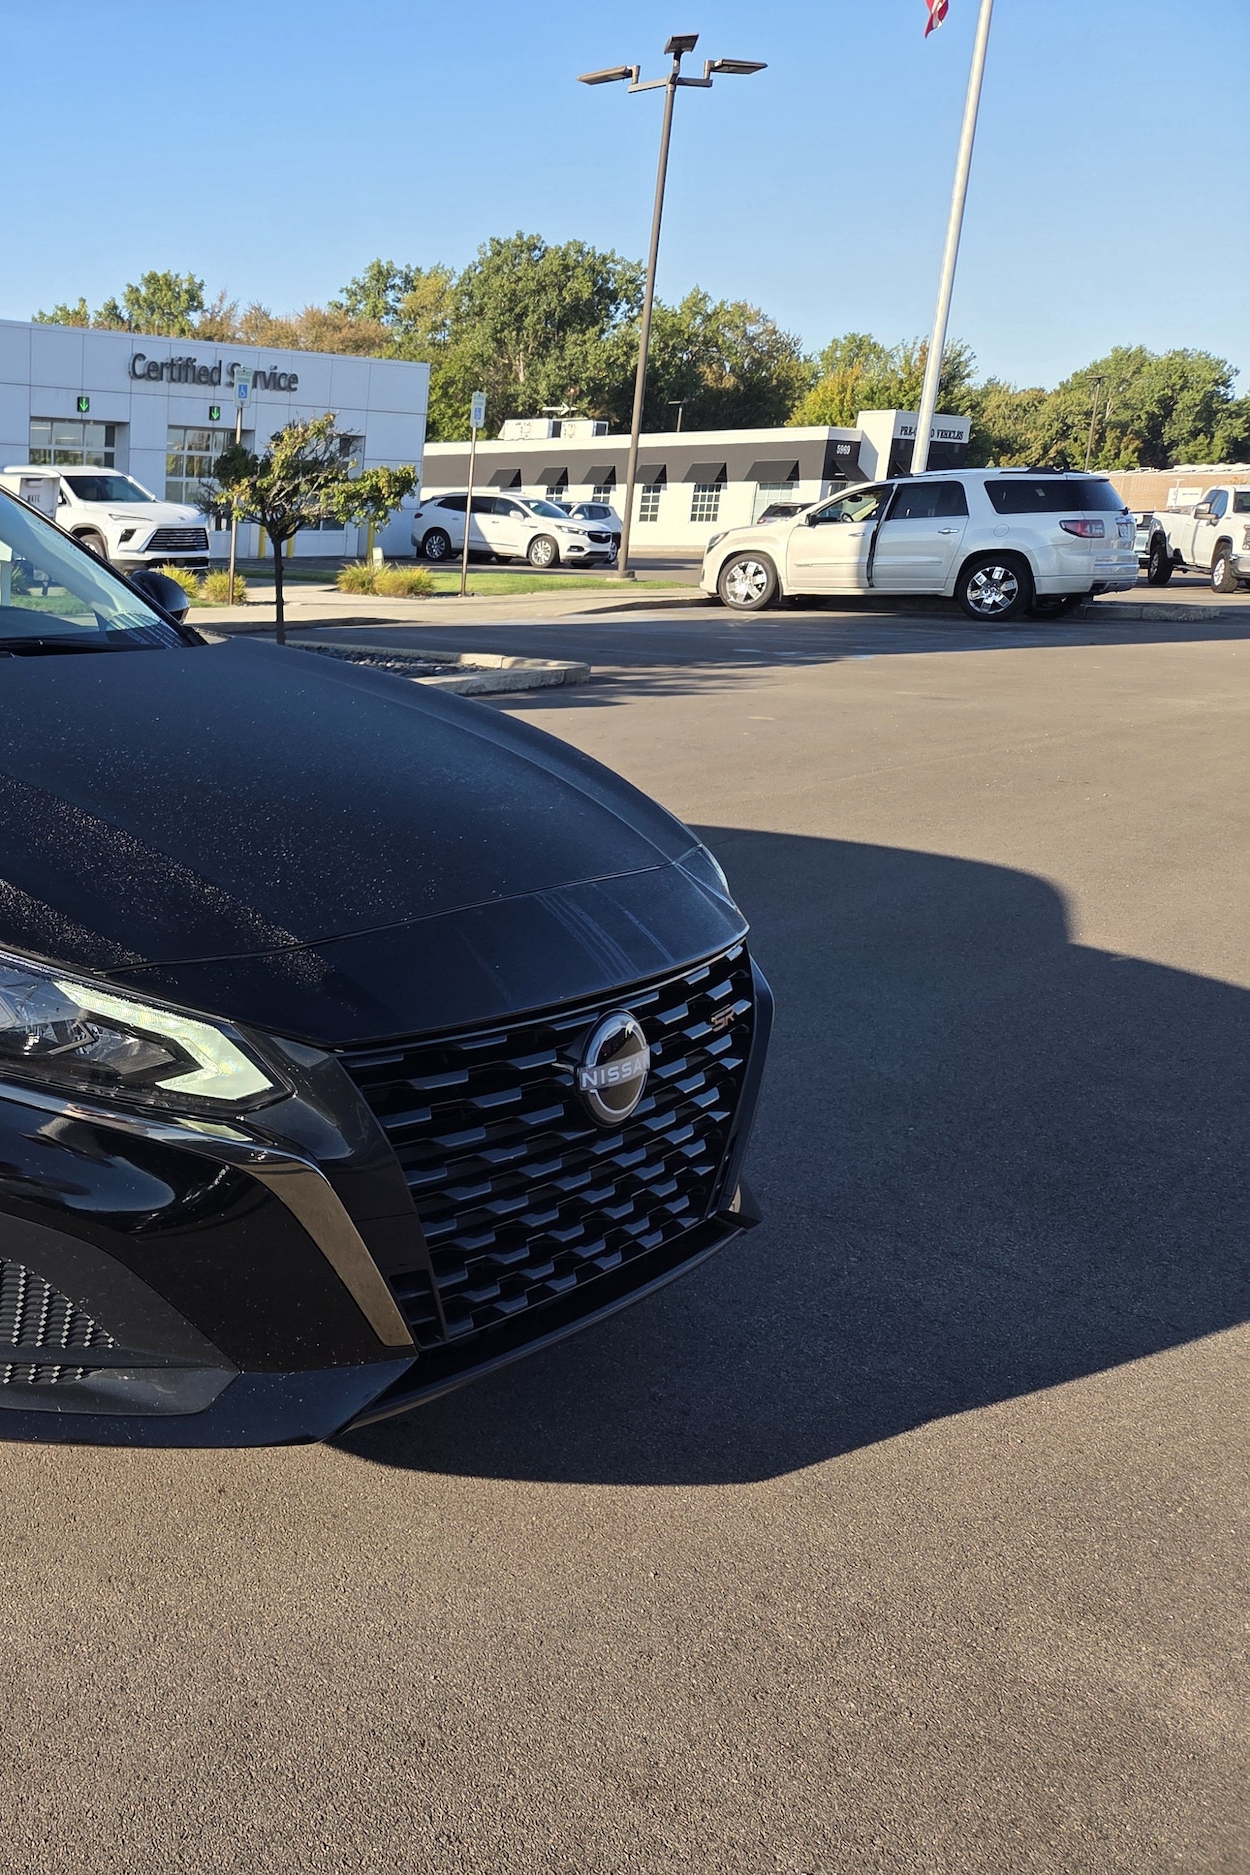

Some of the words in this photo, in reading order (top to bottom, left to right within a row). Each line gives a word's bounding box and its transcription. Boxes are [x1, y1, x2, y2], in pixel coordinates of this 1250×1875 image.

[129, 352, 223, 387] Certified
[226, 362, 299, 392] Srvice
[936, 429, 964, 440] VEHICLES
[581, 1053, 650, 1088] NISSAN
